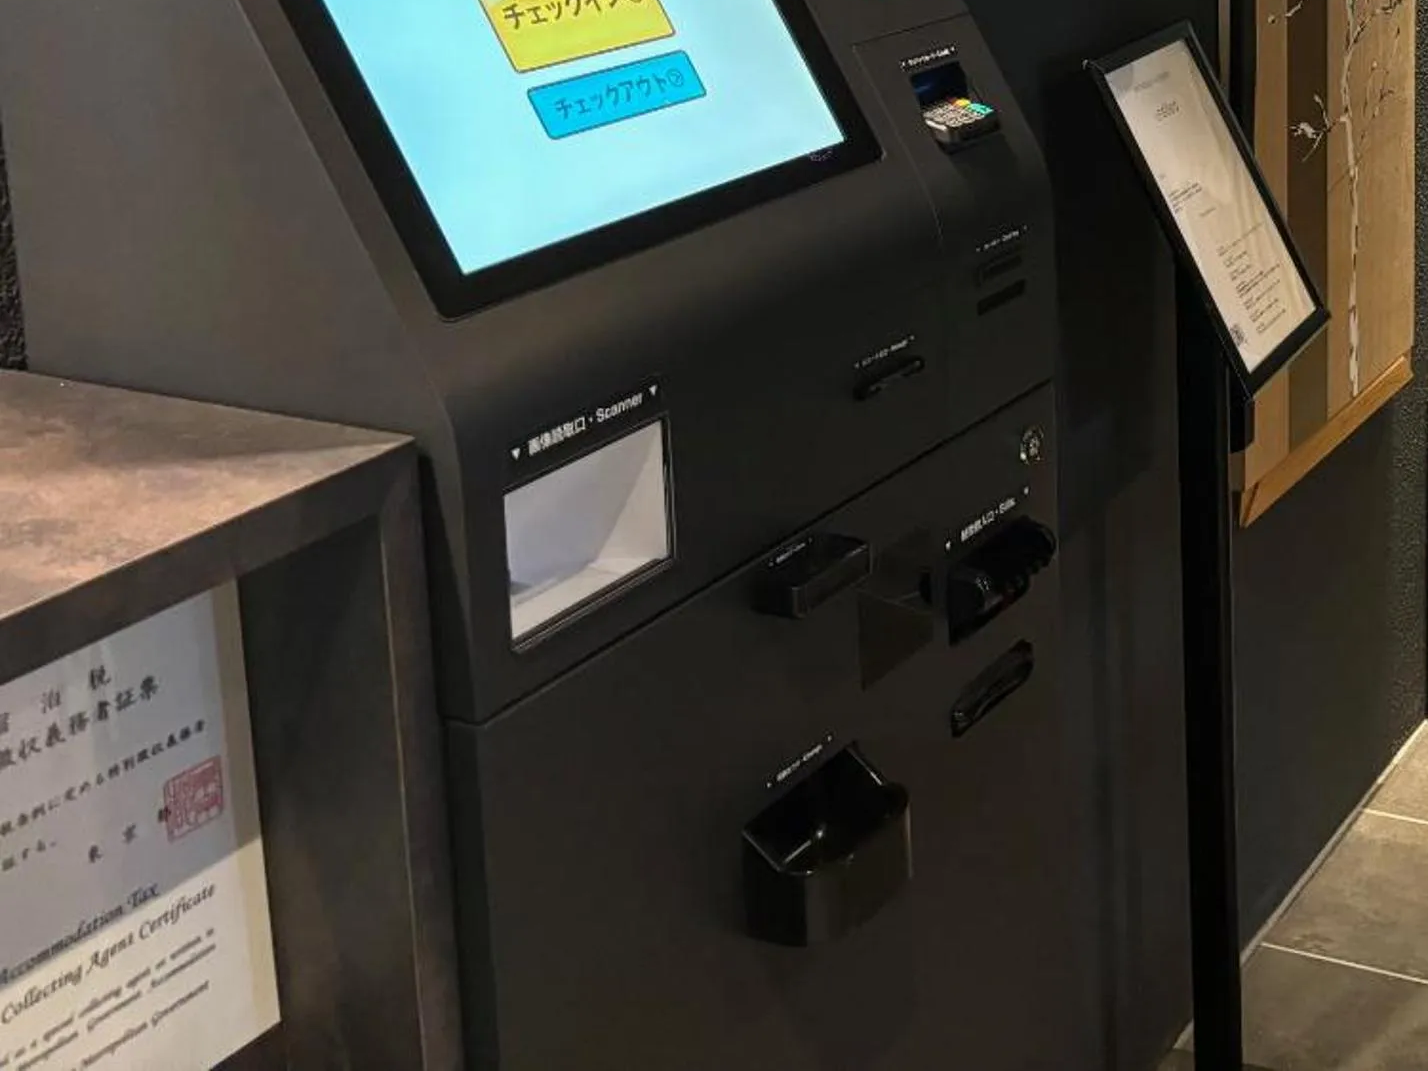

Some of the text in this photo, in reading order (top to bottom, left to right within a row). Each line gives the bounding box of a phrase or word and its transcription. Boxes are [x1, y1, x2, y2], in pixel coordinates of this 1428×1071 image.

[555, 72, 667, 119] チェックアウト
[127, 883, 159, 910] Tax
[1, 965, 82, 1025] Collecting
[86, 932, 135, 977] Agent
[139, 884, 215, 940] Certificate
